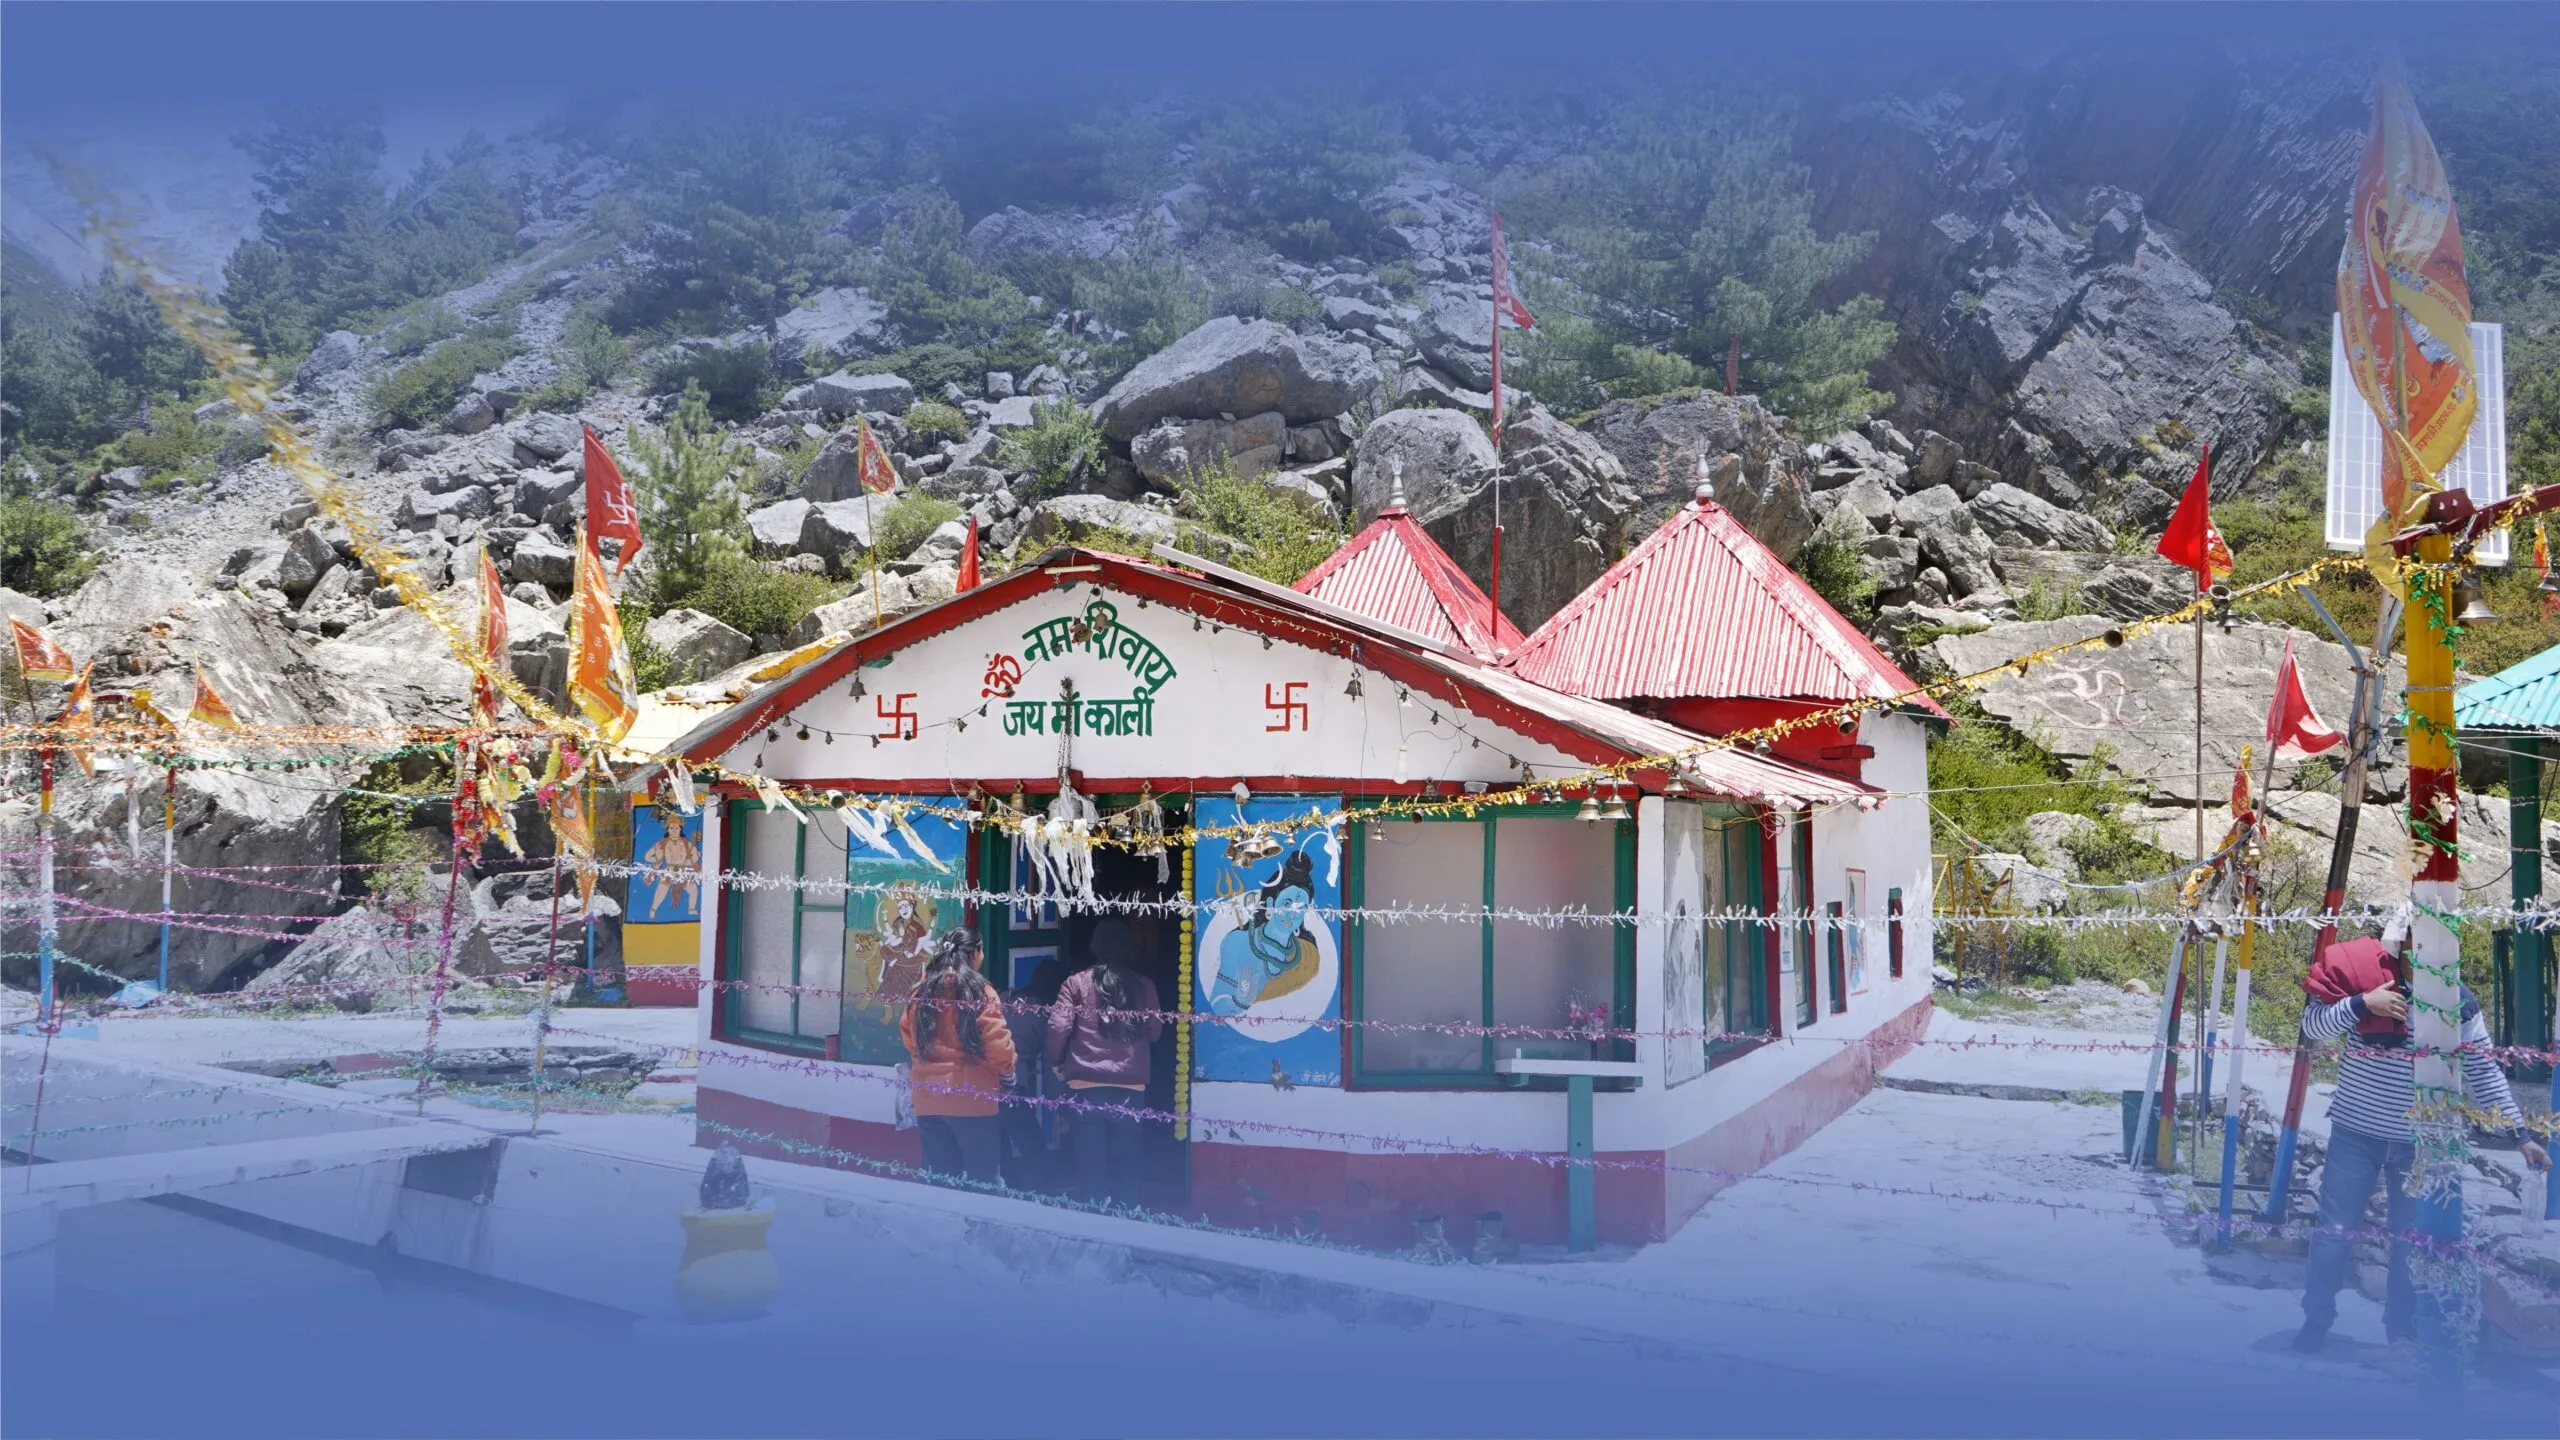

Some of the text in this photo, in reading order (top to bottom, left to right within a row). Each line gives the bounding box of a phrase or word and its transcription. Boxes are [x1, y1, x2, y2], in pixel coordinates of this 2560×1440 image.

[981, 653, 1021, 698] ॐ
[2025, 658, 2146, 729] ॐ
[1003, 701, 1047, 736] जय
[1084, 686, 1155, 737] काली
